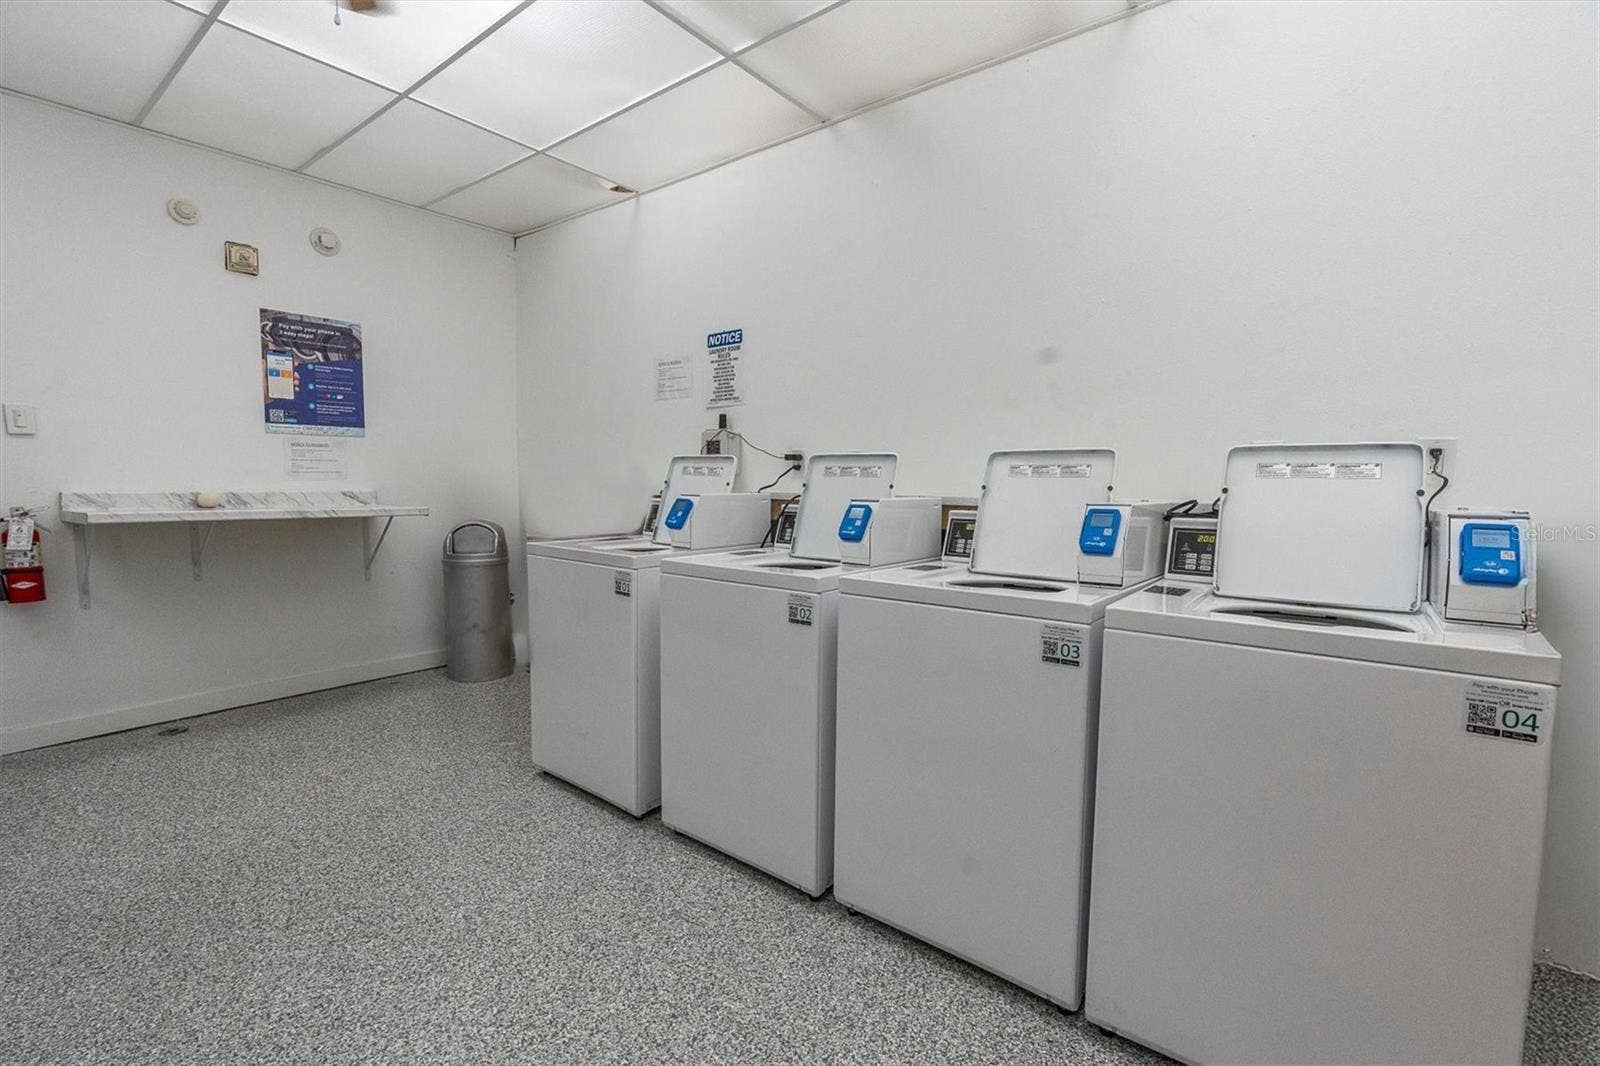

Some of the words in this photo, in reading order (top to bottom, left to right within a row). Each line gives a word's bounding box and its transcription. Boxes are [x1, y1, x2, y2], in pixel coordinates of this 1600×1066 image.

[709, 331, 741, 346] NOTICE
[621, 582, 630, 593] 01
[799, 607, 812, 620] 02
[1060, 643, 1080, 659] 03
[1502, 709, 1540, 732] 04
